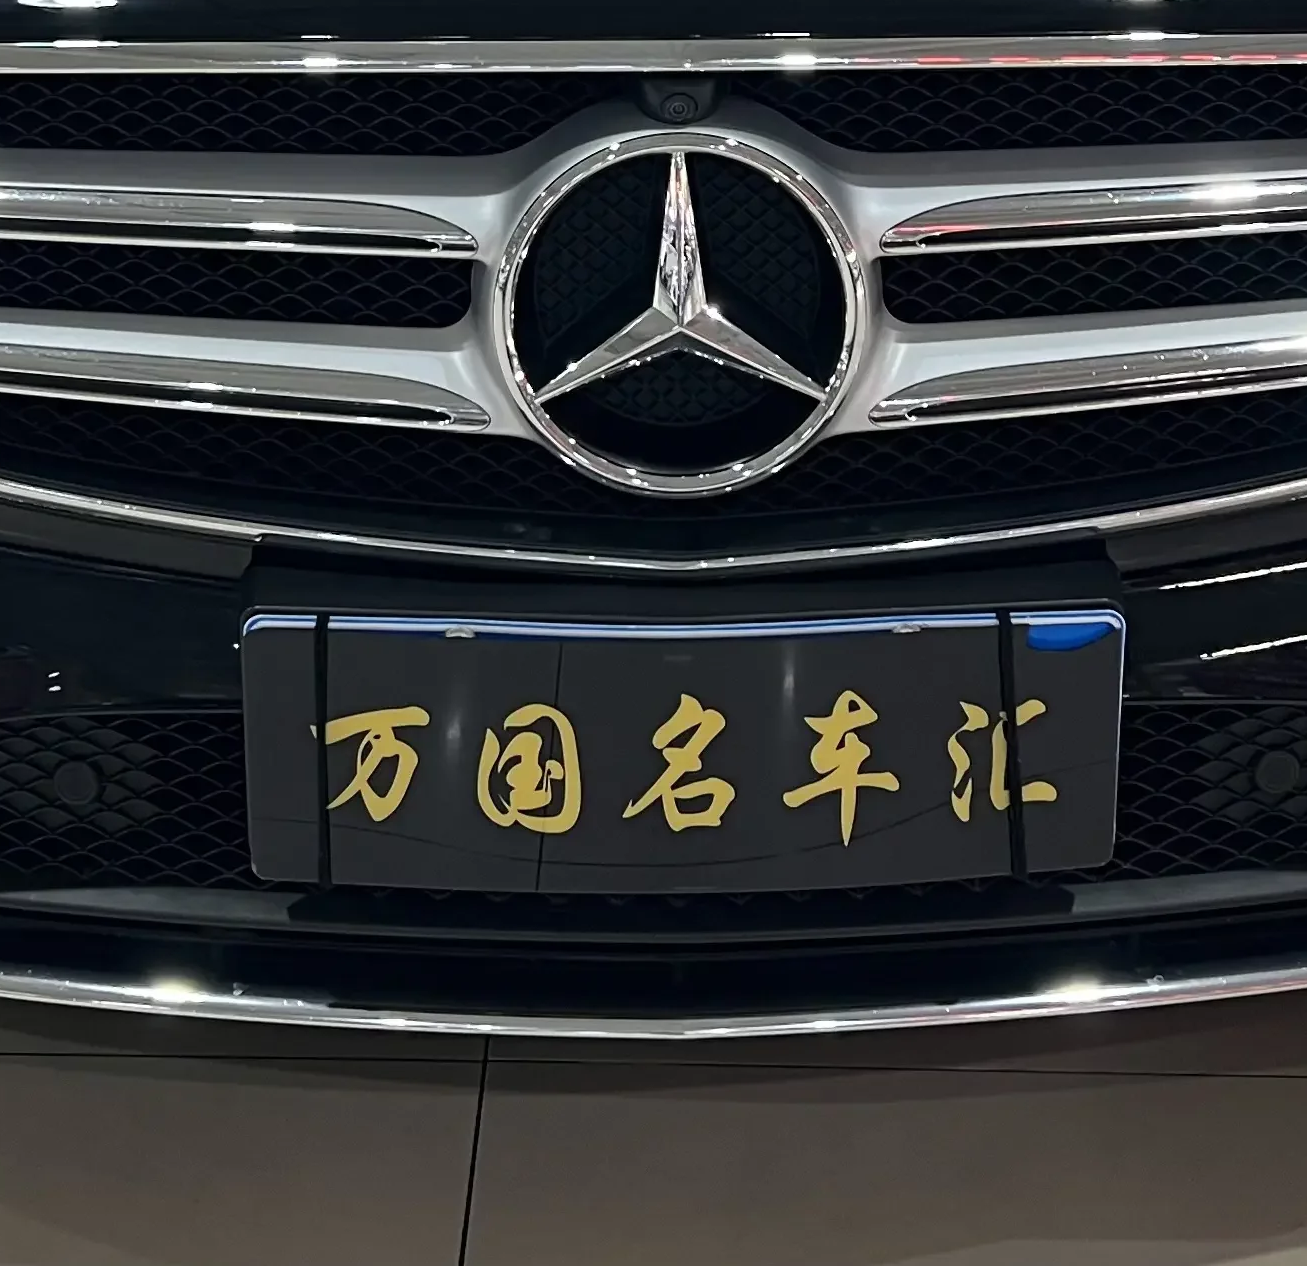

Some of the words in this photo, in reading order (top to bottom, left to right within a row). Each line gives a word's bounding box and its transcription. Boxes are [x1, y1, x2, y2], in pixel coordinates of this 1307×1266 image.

[310, 689, 1058, 846] 万国名车汇
